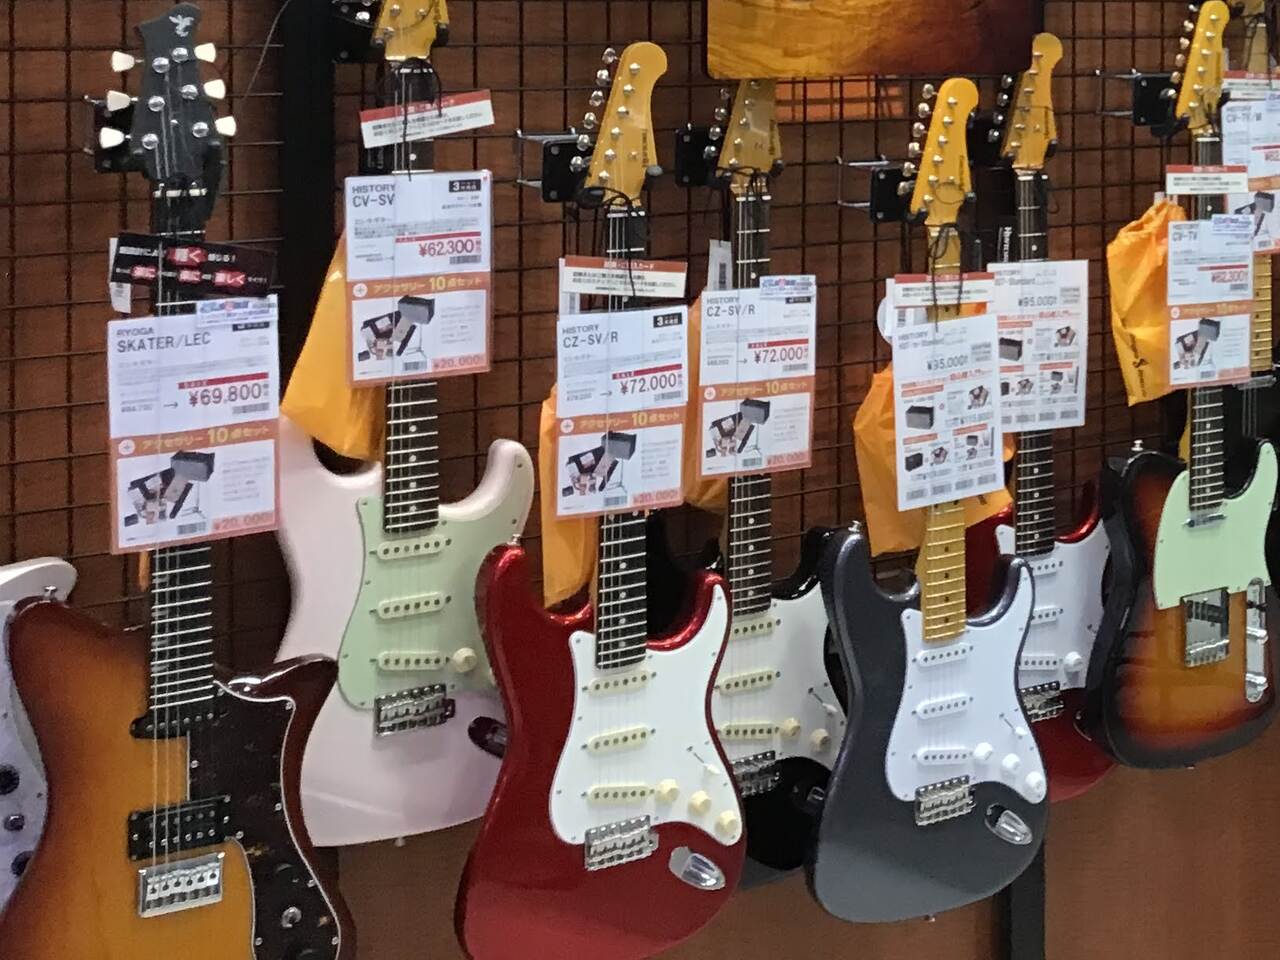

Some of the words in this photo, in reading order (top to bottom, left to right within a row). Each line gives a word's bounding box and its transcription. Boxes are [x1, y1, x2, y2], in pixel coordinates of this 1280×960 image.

[352, 183, 396, 195] HISTORY
[419, 238, 474, 258] ¥62,300
[116, 327, 154, 337] RYOGA
[562, 331, 618, 349] CZ-SV/R
[116, 331, 212, 354] SKATER/LEC
[754, 346, 804, 364] ¥72,000
[620, 372, 678, 396] ¥72,000
[188, 383, 262, 408] ¥69,800
